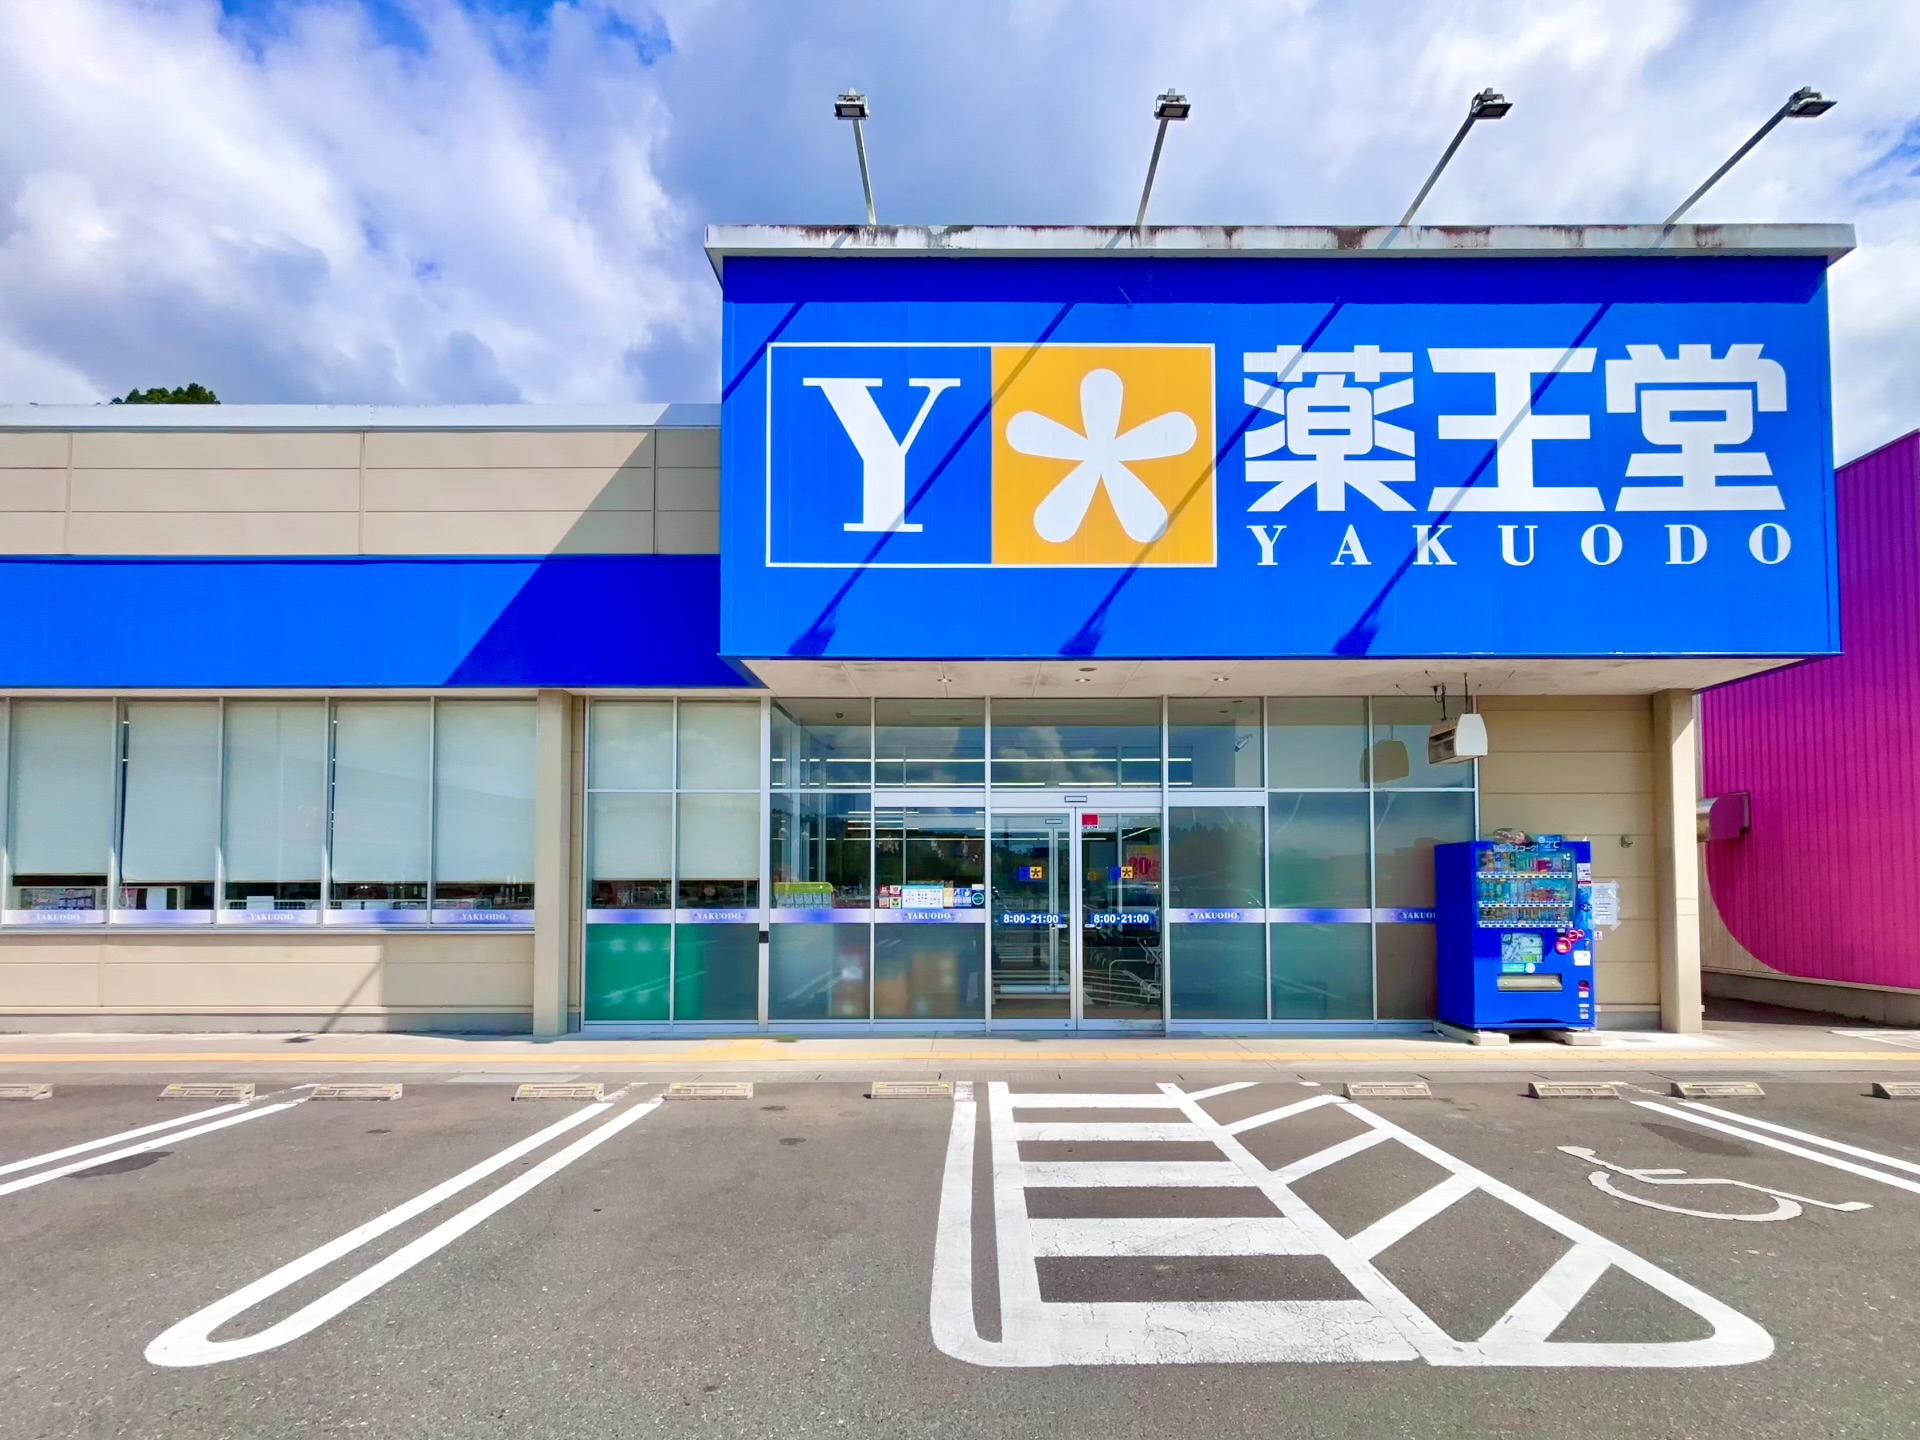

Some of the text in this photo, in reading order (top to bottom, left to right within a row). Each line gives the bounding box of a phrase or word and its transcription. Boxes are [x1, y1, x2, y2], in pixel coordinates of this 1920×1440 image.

[1243, 344, 1787, 512] 薬王堂
[803, 377, 961, 533] Y
[1246, 522, 1791, 567] YAKUODO
[250, 912, 294, 921] YAKUODO
[461, 912, 507, 920] YAKUODO
[698, 911, 741, 920] YAKUODO
[907, 911, 951, 920] YAKUODO
[1003, 914, 1059, 923] 8:00-21:00
[1093, 914, 1149, 923] 8:00-21:00
[1194, 911, 1238, 920] YAKUODO
